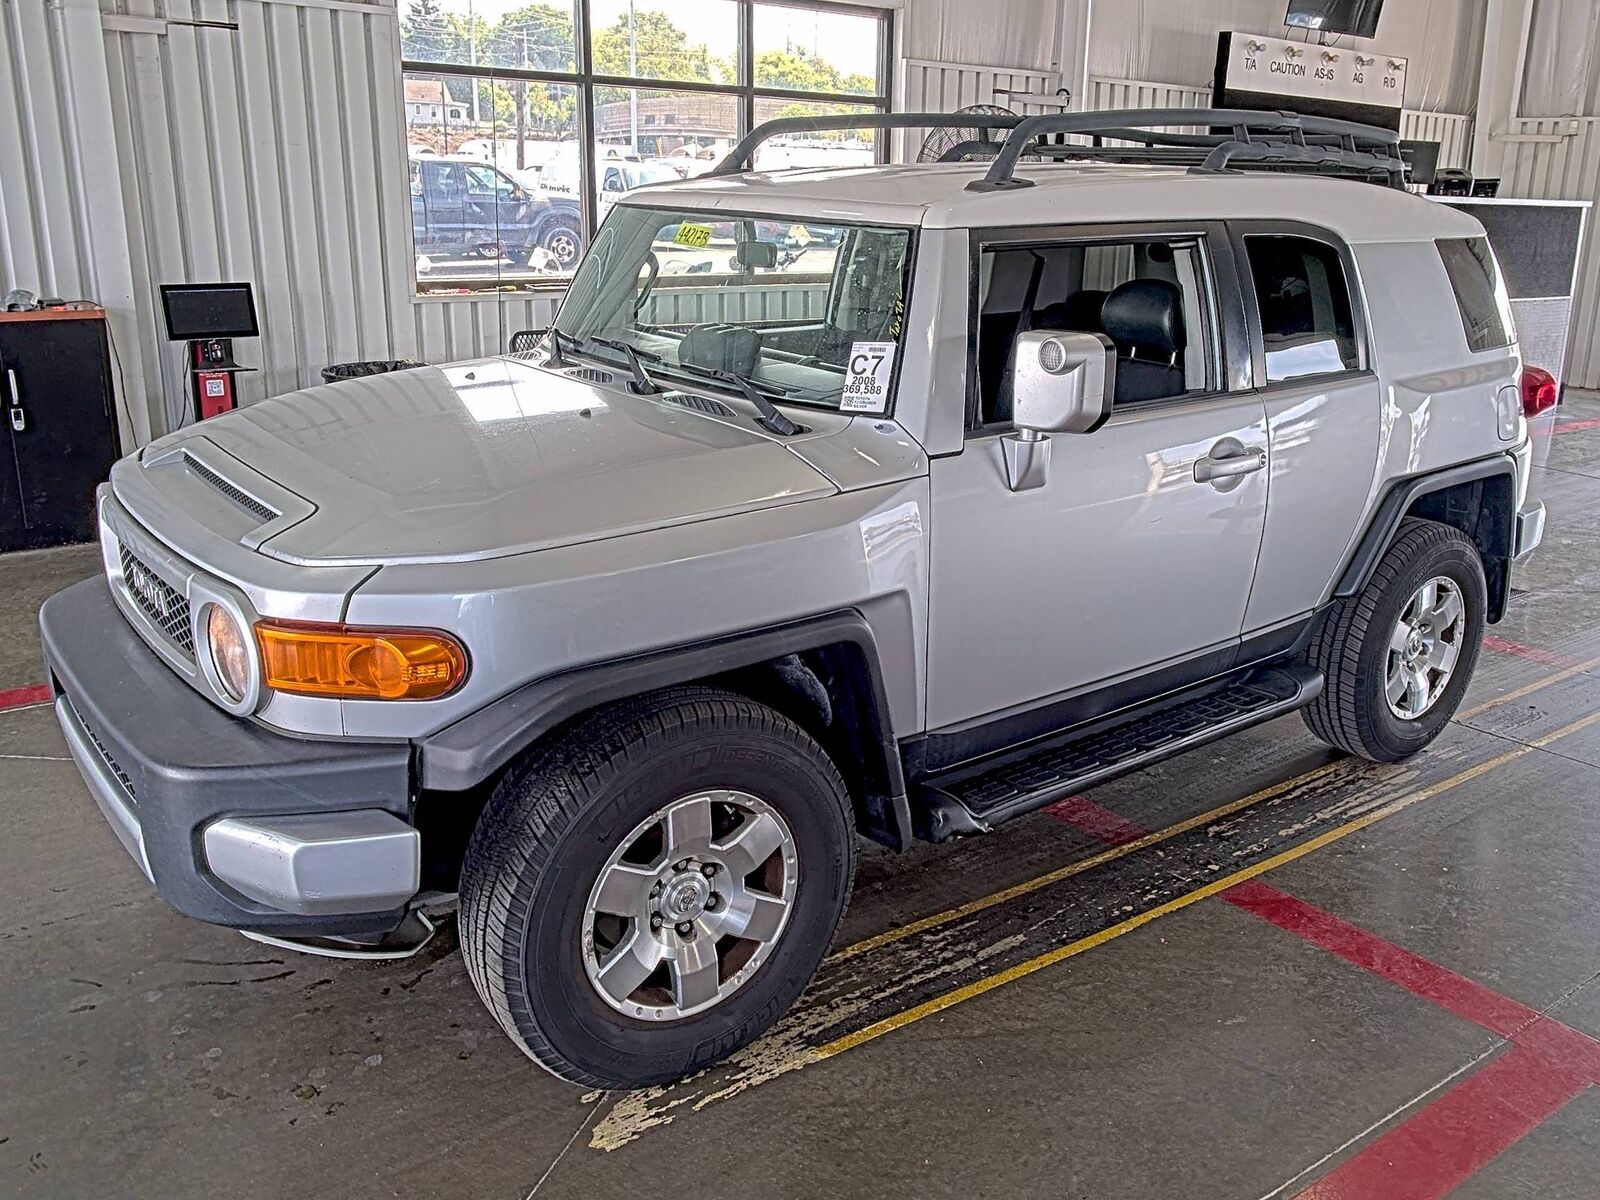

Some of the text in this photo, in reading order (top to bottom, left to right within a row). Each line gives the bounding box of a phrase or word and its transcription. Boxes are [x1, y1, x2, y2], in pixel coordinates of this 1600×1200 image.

[1244, 57, 1257, 71] T/A
[1270, 60, 1306, 77] CAUTION
[1314, 67, 1335, 81] AS-IS
[1352, 72, 1364, 84] AG
[850, 354, 885, 376] C7
[852, 375, 876, 386] 2008
[842, 384, 882, 395] 369,588
